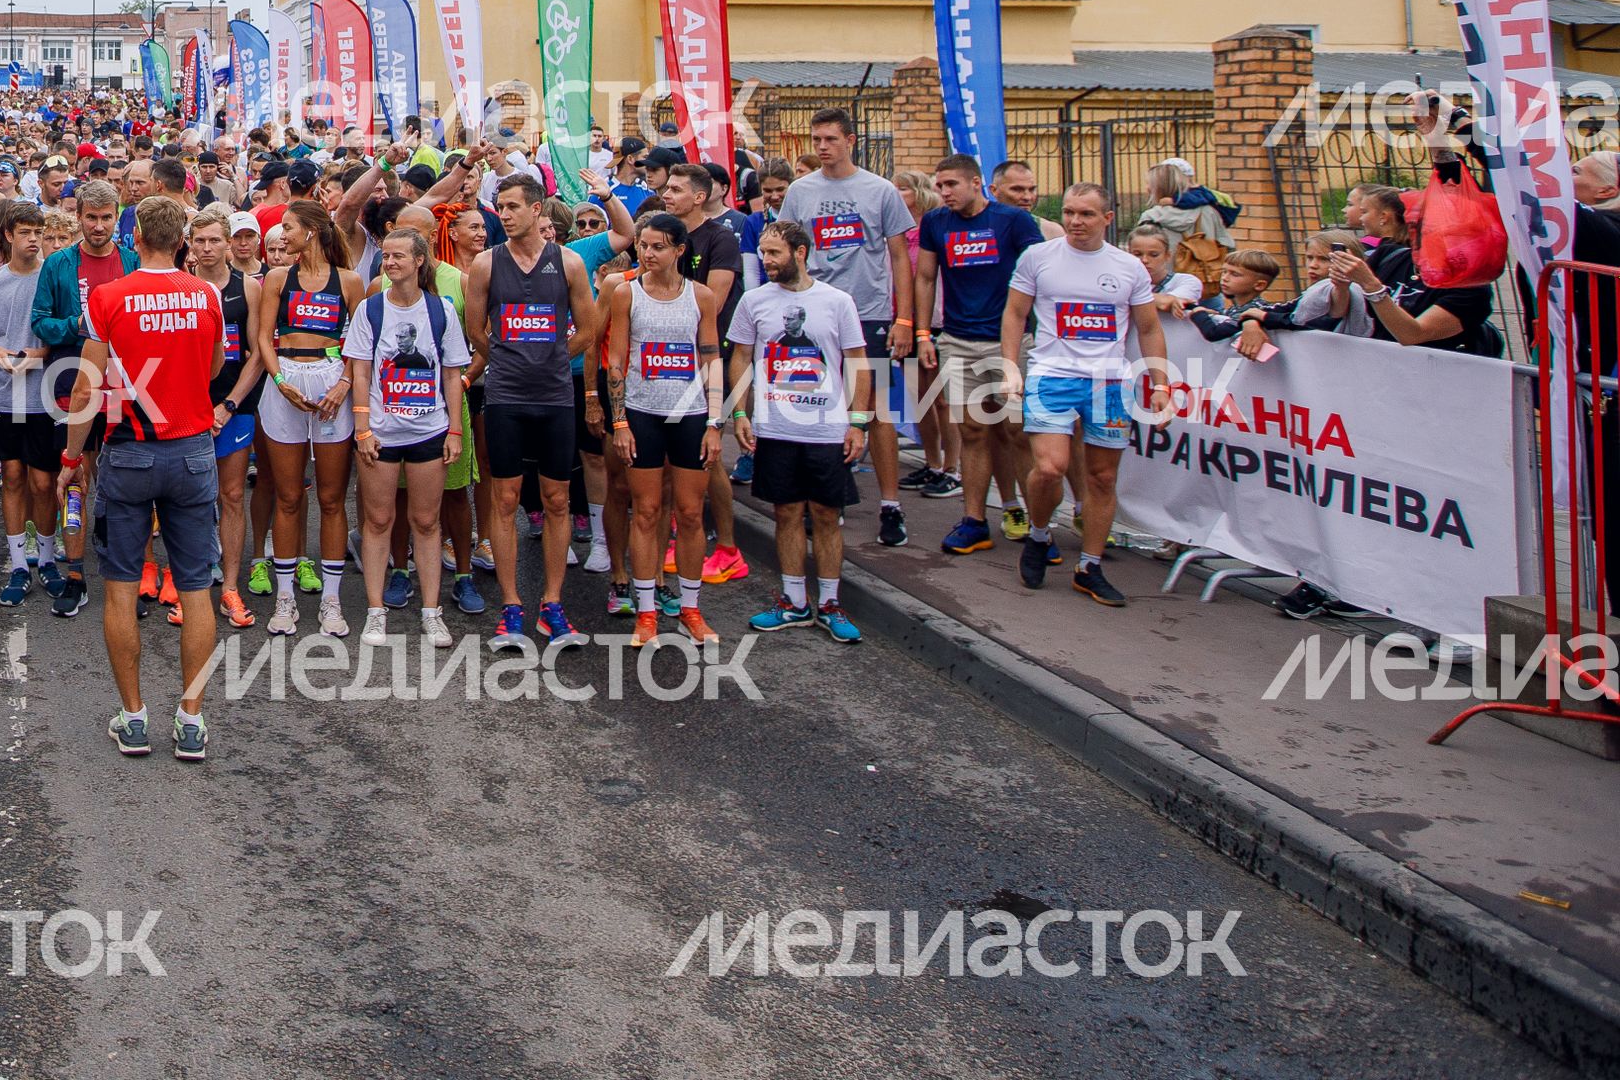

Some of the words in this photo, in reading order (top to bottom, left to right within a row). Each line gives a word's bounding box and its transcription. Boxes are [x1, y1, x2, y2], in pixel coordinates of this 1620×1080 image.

[821, 226, 855, 239] 9228
[953, 242, 987, 255] 9227
[124, 289, 208, 313] ГЛАВНЫЙ
[296, 304, 330, 318] 8322
[139, 310, 198, 334] СУДЬЯ
[506, 317, 550, 329] 10852
[1063, 315, 1108, 329] 10631
[646, 355, 690, 368] 10853
[772, 360, 812, 372] 8242
[388, 381, 431, 394] 10728
[1128, 422, 1191, 471] АРА
[1198, 440, 1475, 550] КРЕМЛЕВА
